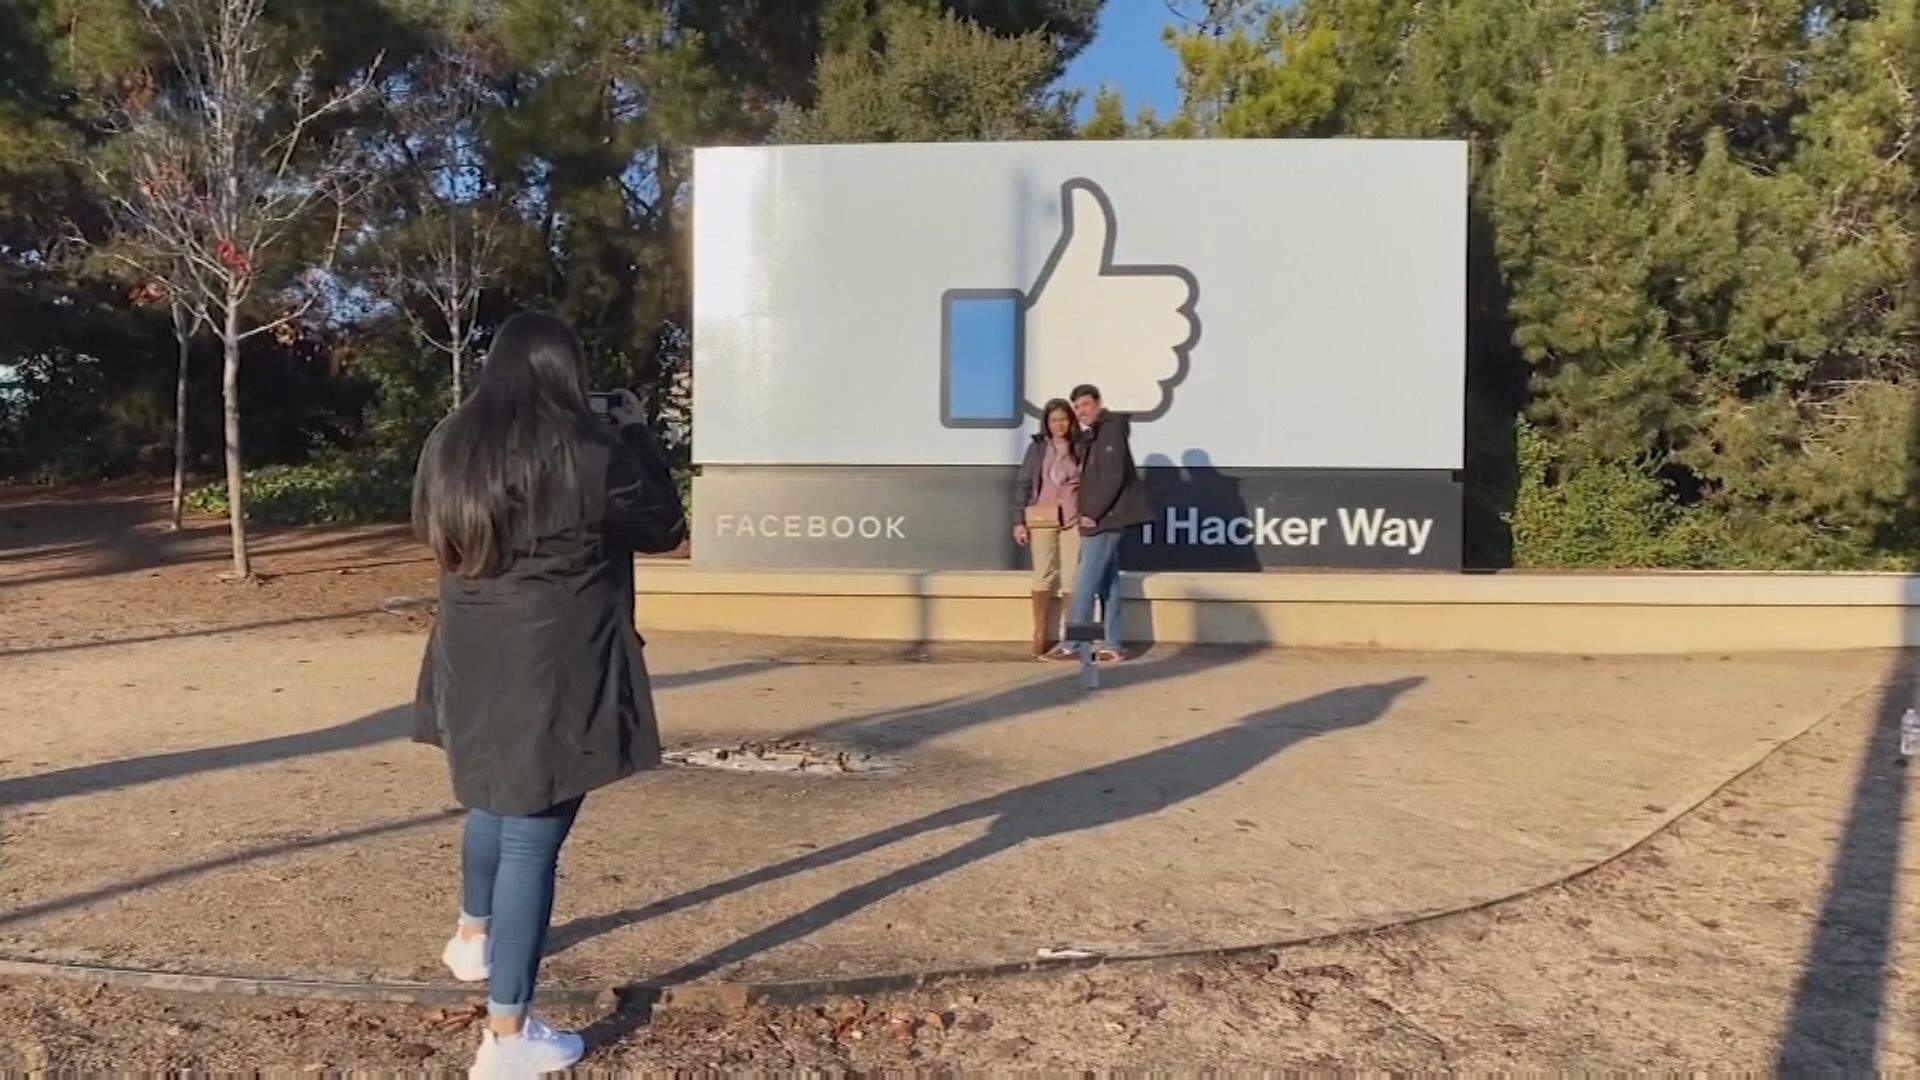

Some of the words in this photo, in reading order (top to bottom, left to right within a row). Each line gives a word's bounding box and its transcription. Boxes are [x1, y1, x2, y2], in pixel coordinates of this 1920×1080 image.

[716, 514, 906, 539] FACEBOOK
[1166, 506, 1327, 546] Hacker
[1337, 508, 1433, 555] Way
